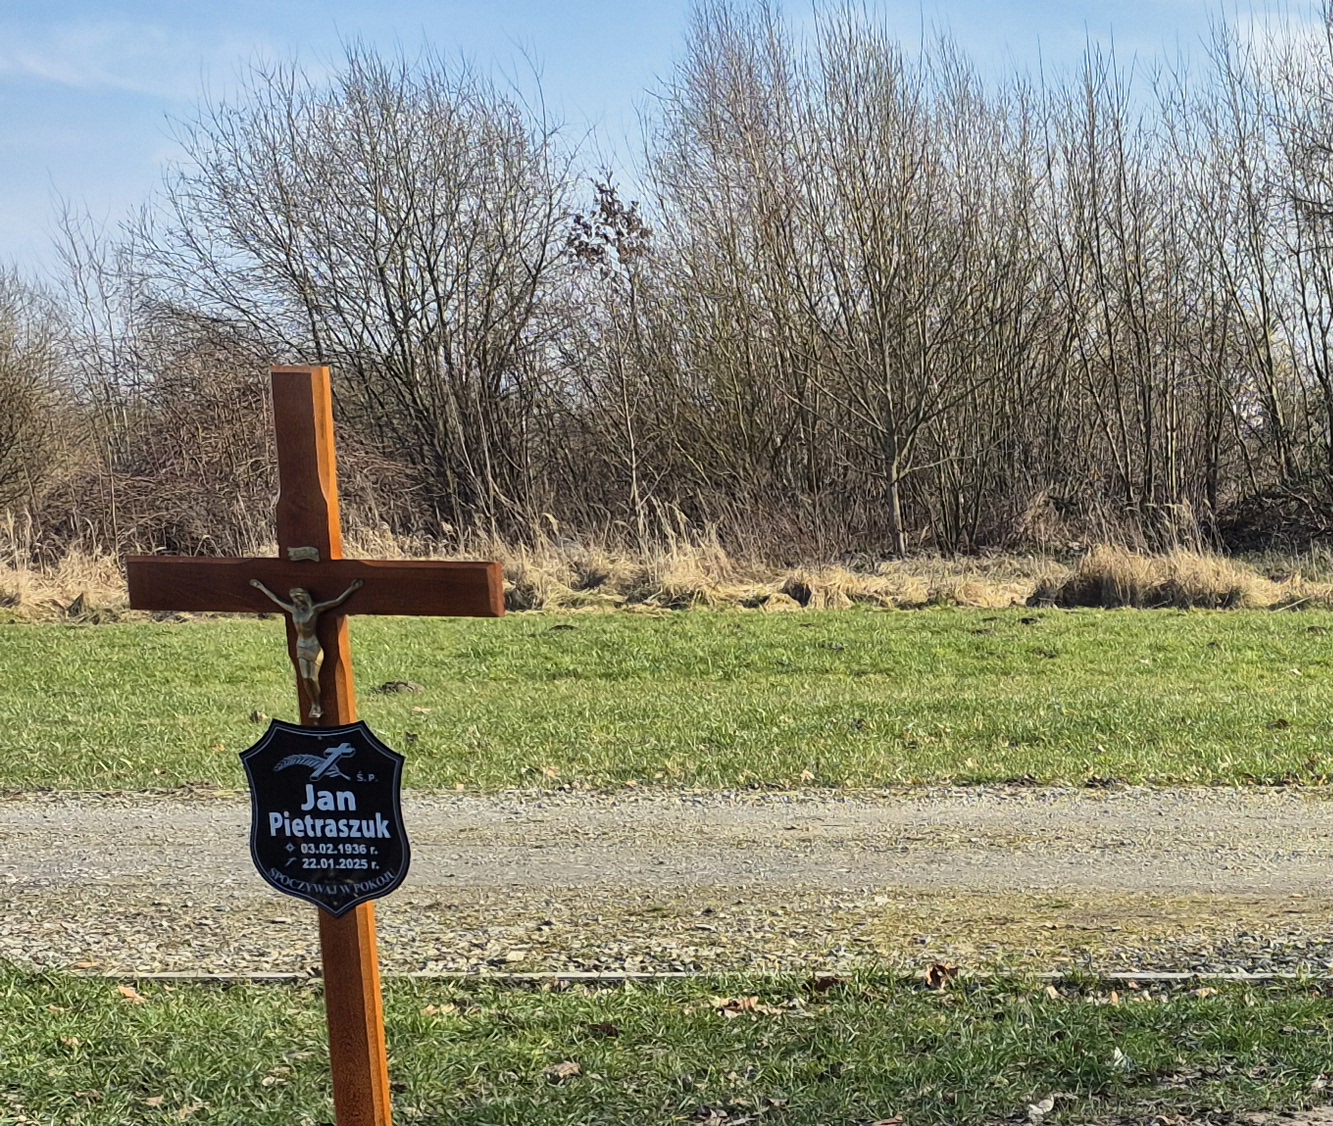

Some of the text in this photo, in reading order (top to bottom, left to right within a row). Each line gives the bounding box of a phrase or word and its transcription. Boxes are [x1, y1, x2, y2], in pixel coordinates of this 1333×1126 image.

[301, 783, 357, 812] Jan
[268, 811, 392, 839] Pietraszuk
[300, 843, 367, 855] 03.02.1936
[302, 858, 368, 869] 22.01.2025
[268, 867, 397, 895] SPOCZYWAJ W POKOJU
